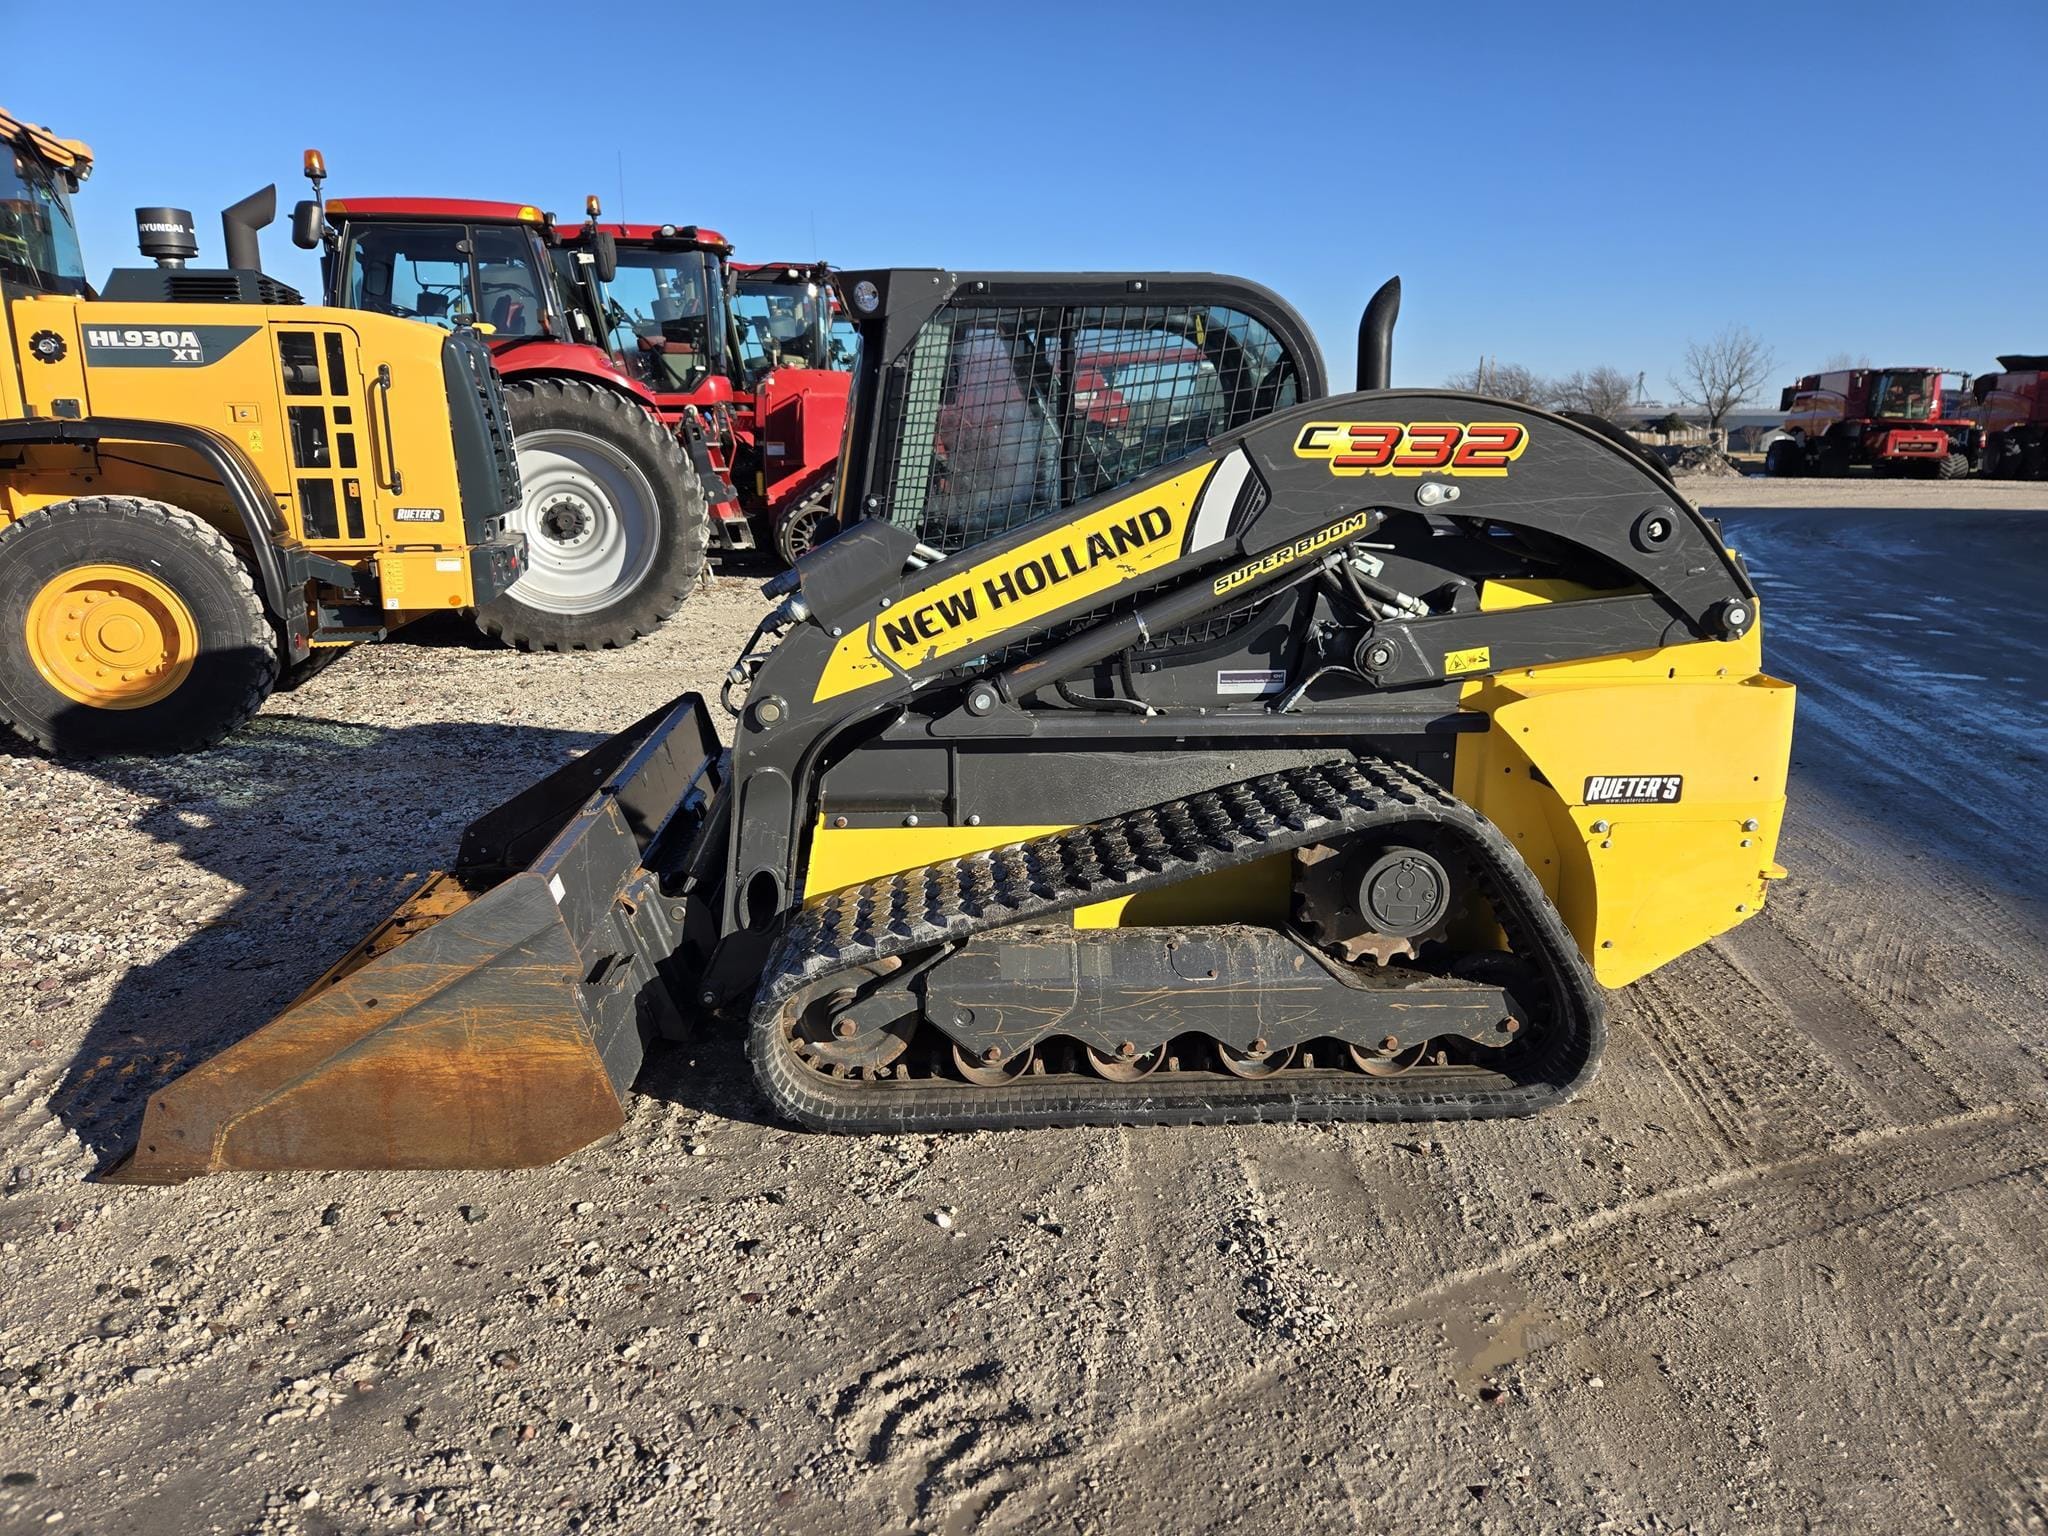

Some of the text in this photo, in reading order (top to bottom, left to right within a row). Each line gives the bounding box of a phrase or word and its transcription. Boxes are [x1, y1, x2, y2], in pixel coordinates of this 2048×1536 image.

[139, 223, 185, 233] HYUNDAI
[88, 330, 199, 348] HL930A
[171, 349, 200, 361] XT
[1295, 424, 1526, 472] C332
[397, 508, 441, 520] RUETER'S
[1214, 511, 1367, 596] SUPER BOOM
[882, 505, 1173, 654] NEW HOLLAND
[1585, 776, 1681, 801] RUETER'S
